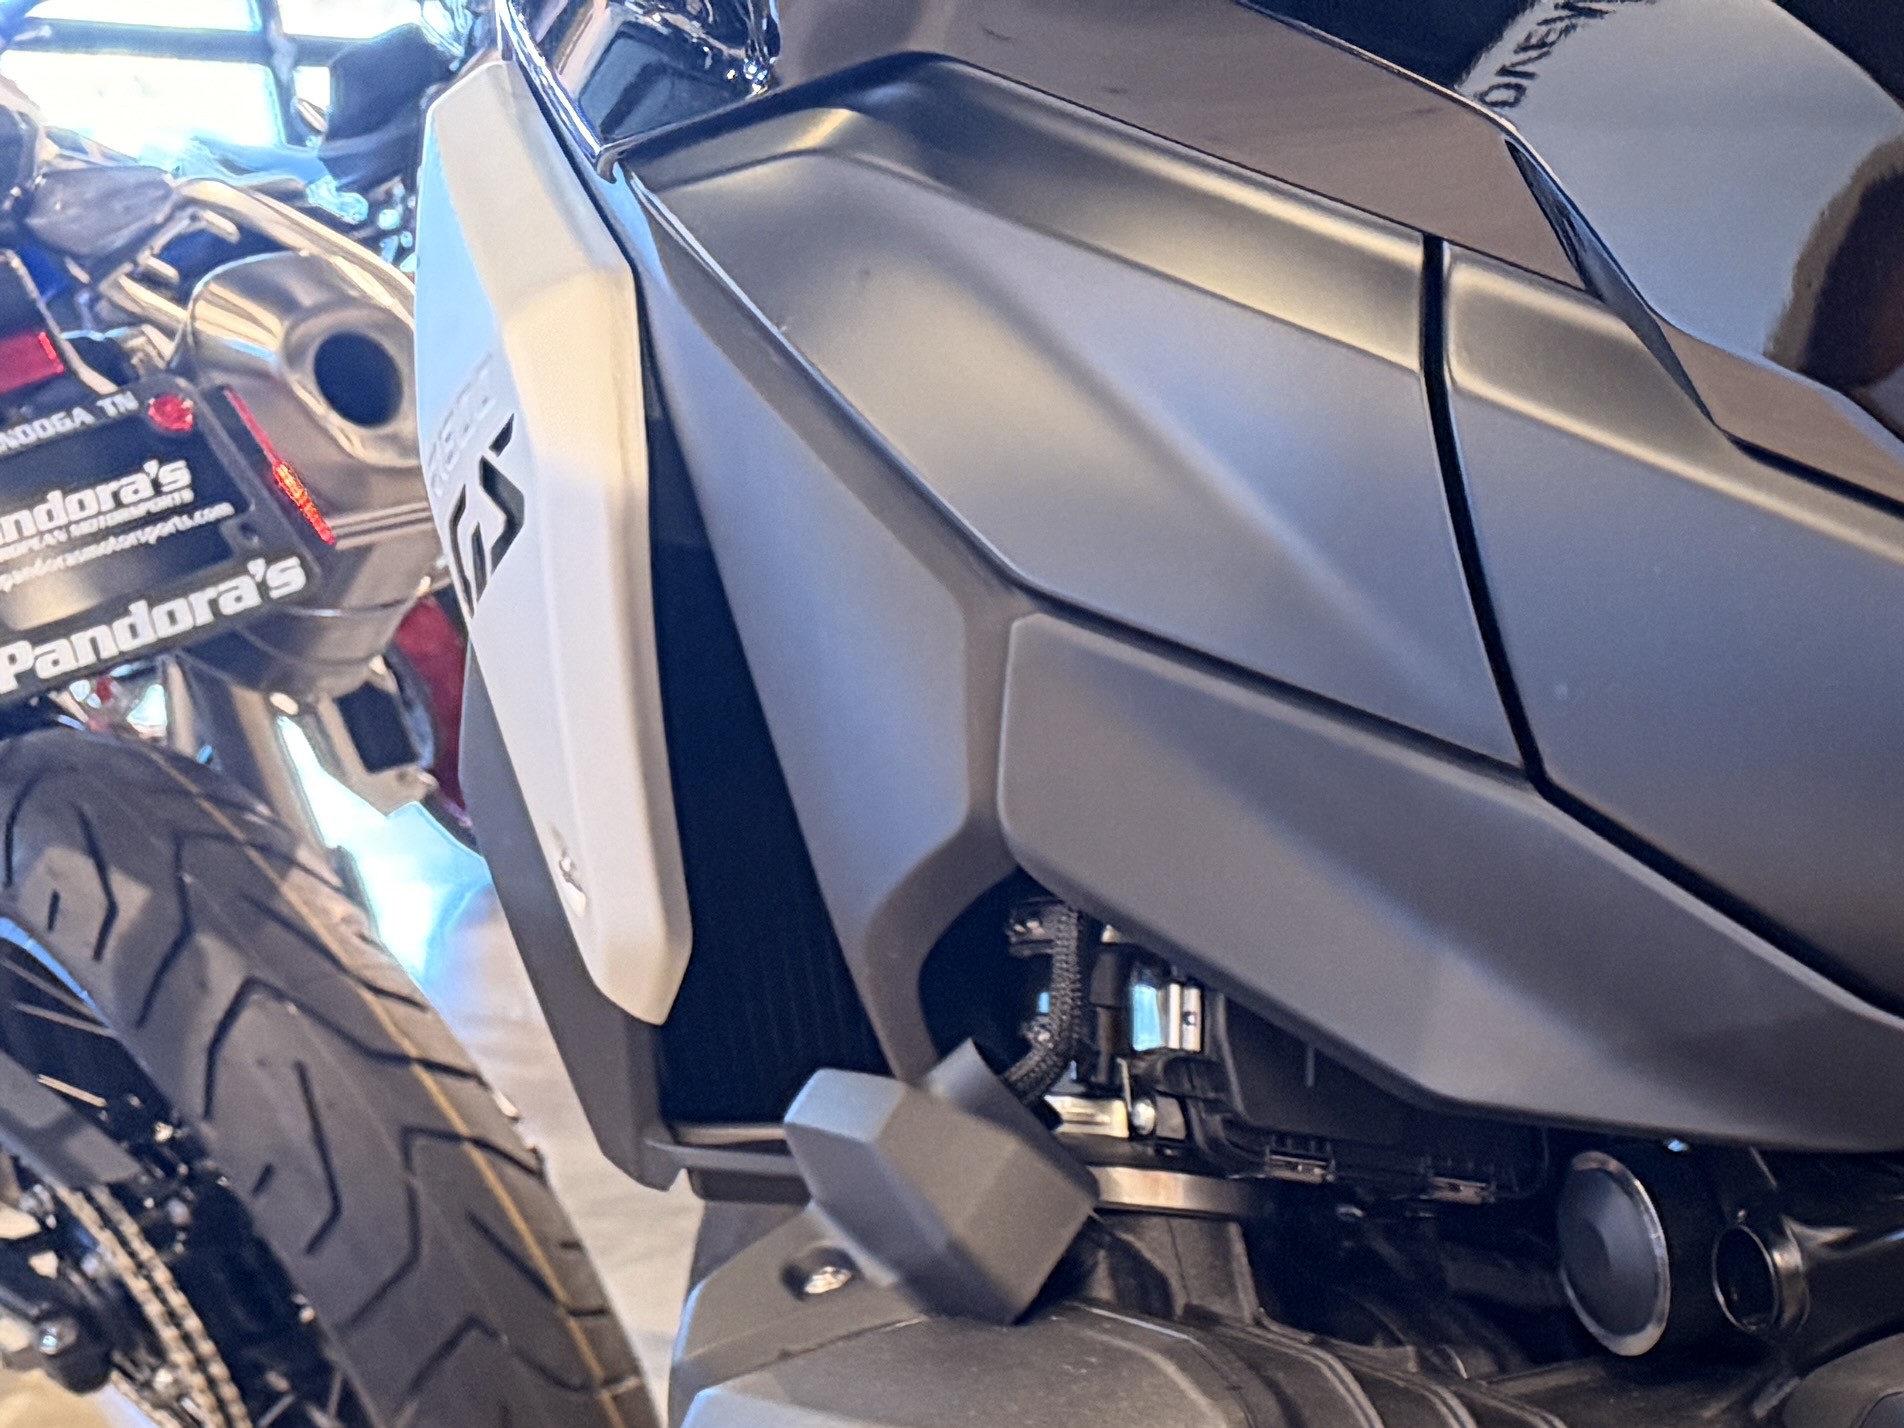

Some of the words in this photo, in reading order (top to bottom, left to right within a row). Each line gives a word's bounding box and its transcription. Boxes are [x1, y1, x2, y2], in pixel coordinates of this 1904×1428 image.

[96, 391, 139, 418] TN
[0, 459, 191, 545] ndora's
[0, 557, 306, 694] Pandora's
